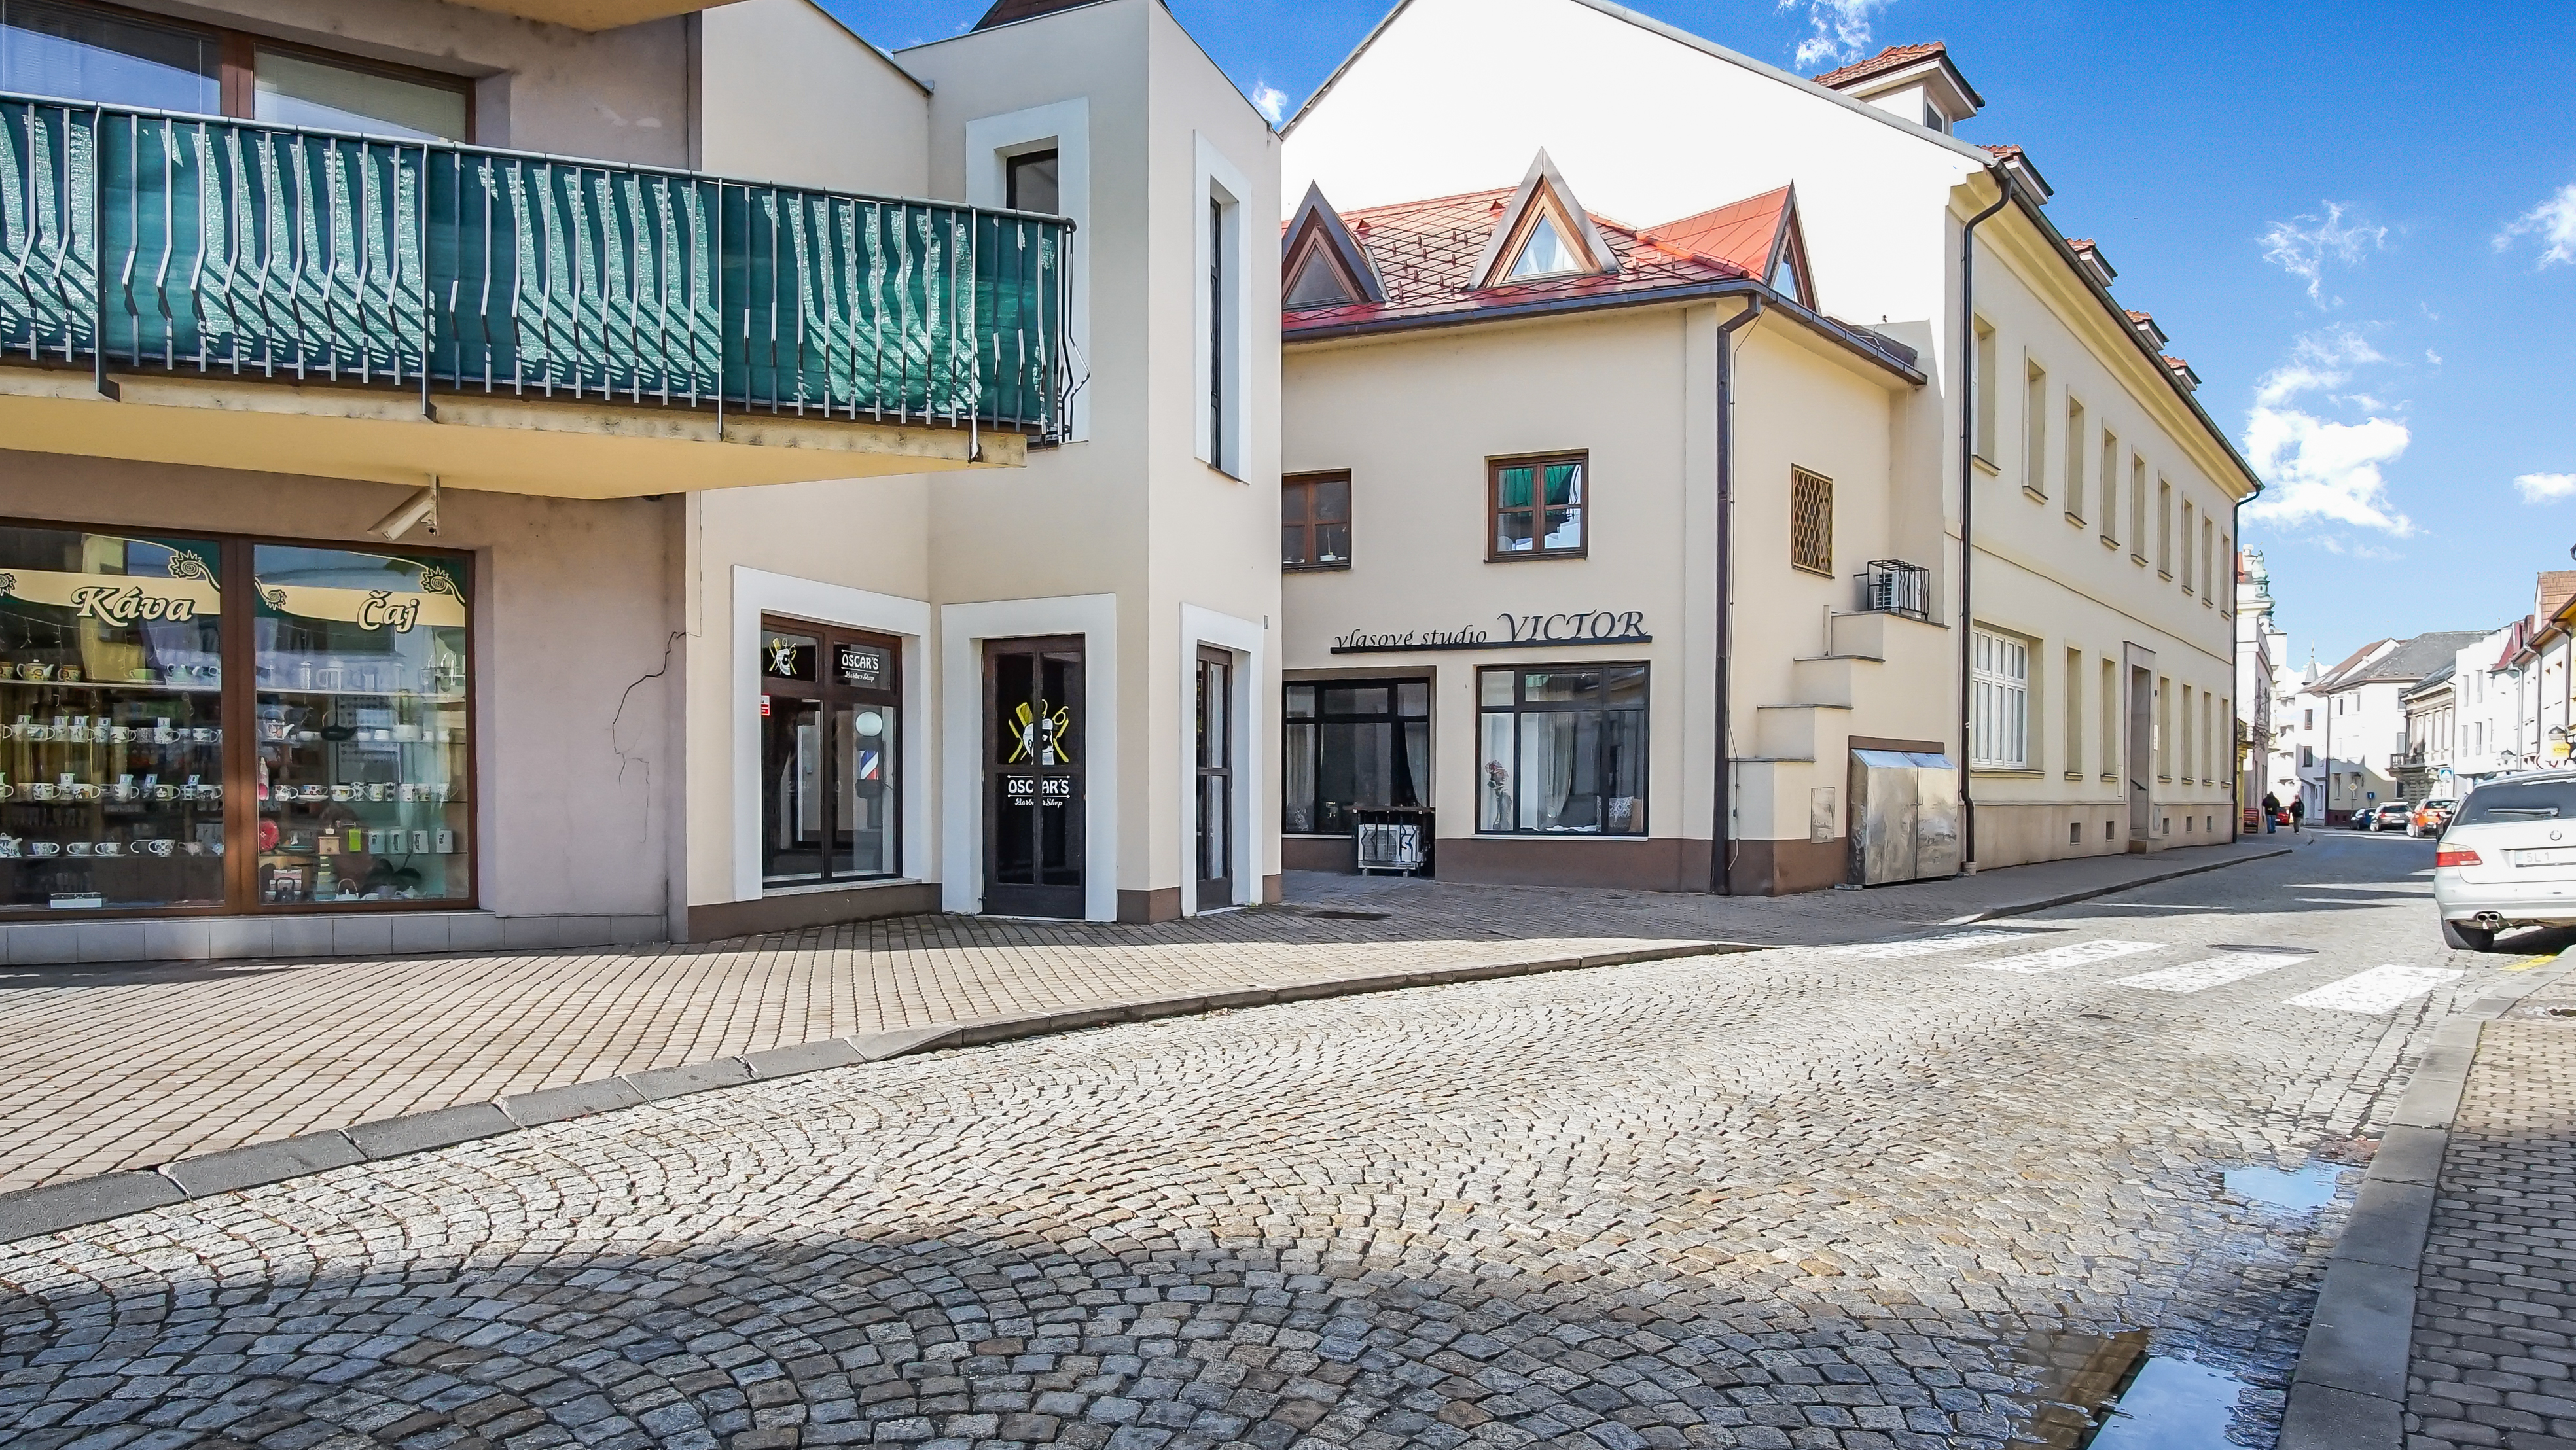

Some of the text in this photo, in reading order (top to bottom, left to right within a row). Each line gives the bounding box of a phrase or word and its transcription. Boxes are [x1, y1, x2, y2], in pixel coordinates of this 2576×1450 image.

[71, 586, 196, 628] Káva
[357, 590, 420, 634] Čaj
[1334, 609, 1649, 648] vlasové studio VICTOR
[842, 654, 879, 670] OSCAR'S
